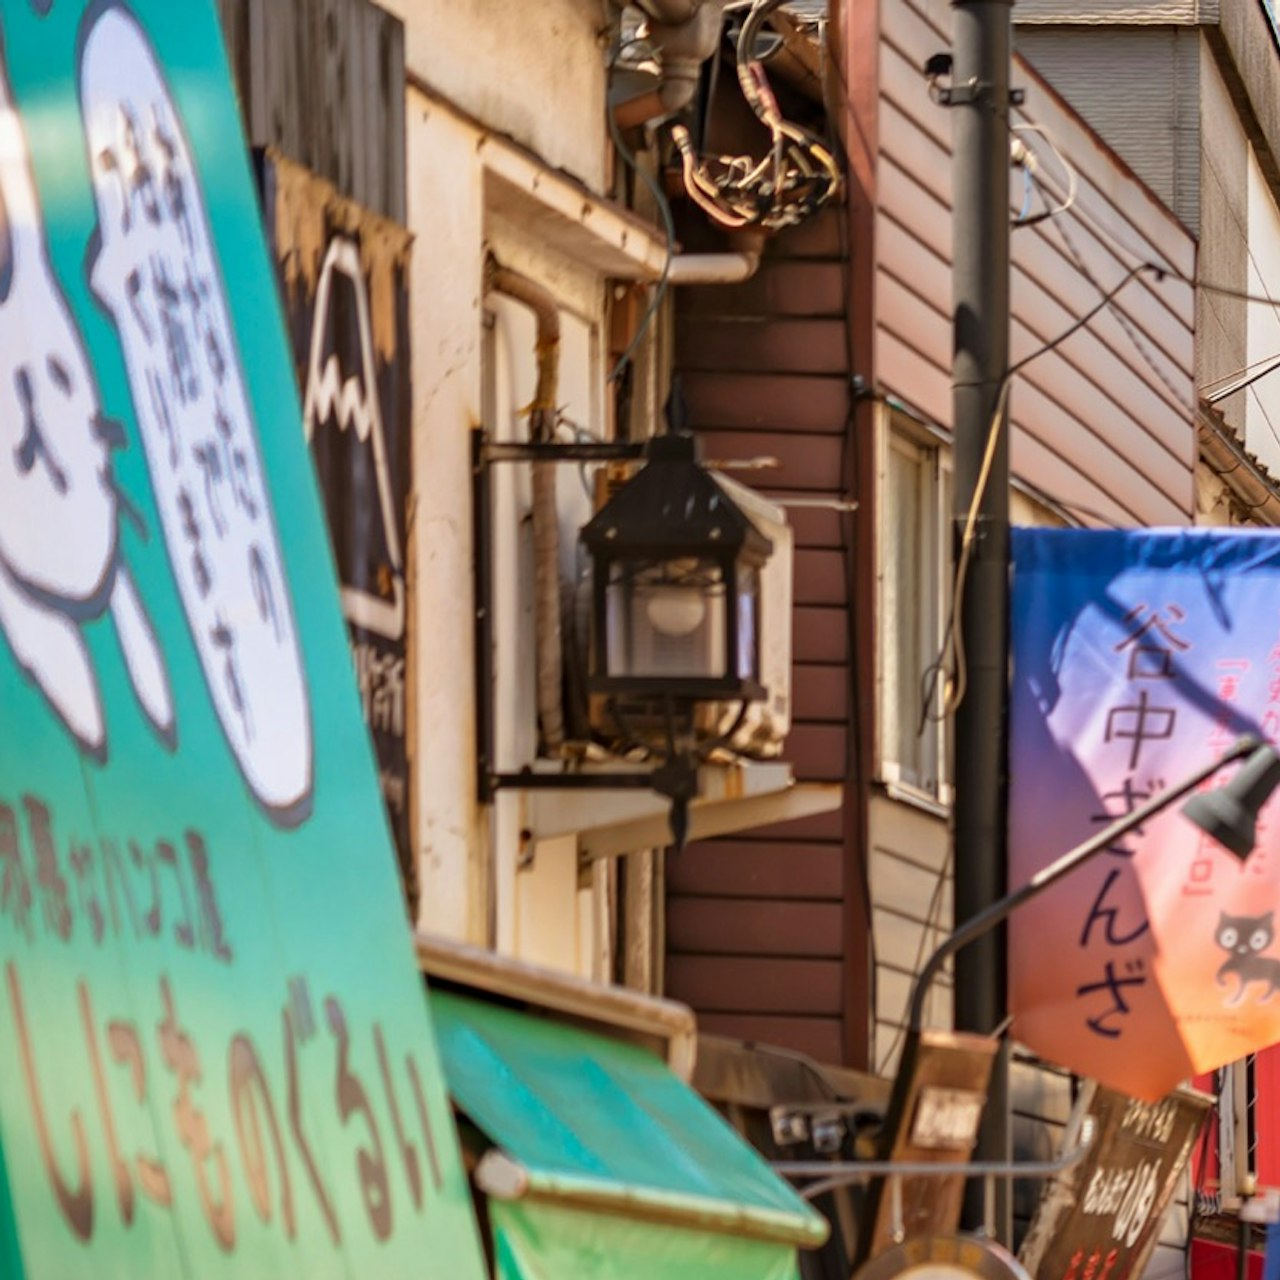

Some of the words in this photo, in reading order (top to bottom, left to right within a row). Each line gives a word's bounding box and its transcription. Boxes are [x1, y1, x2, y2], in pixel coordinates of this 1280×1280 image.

[1076, 599, 1196, 1041] 谷中ぎんざ
